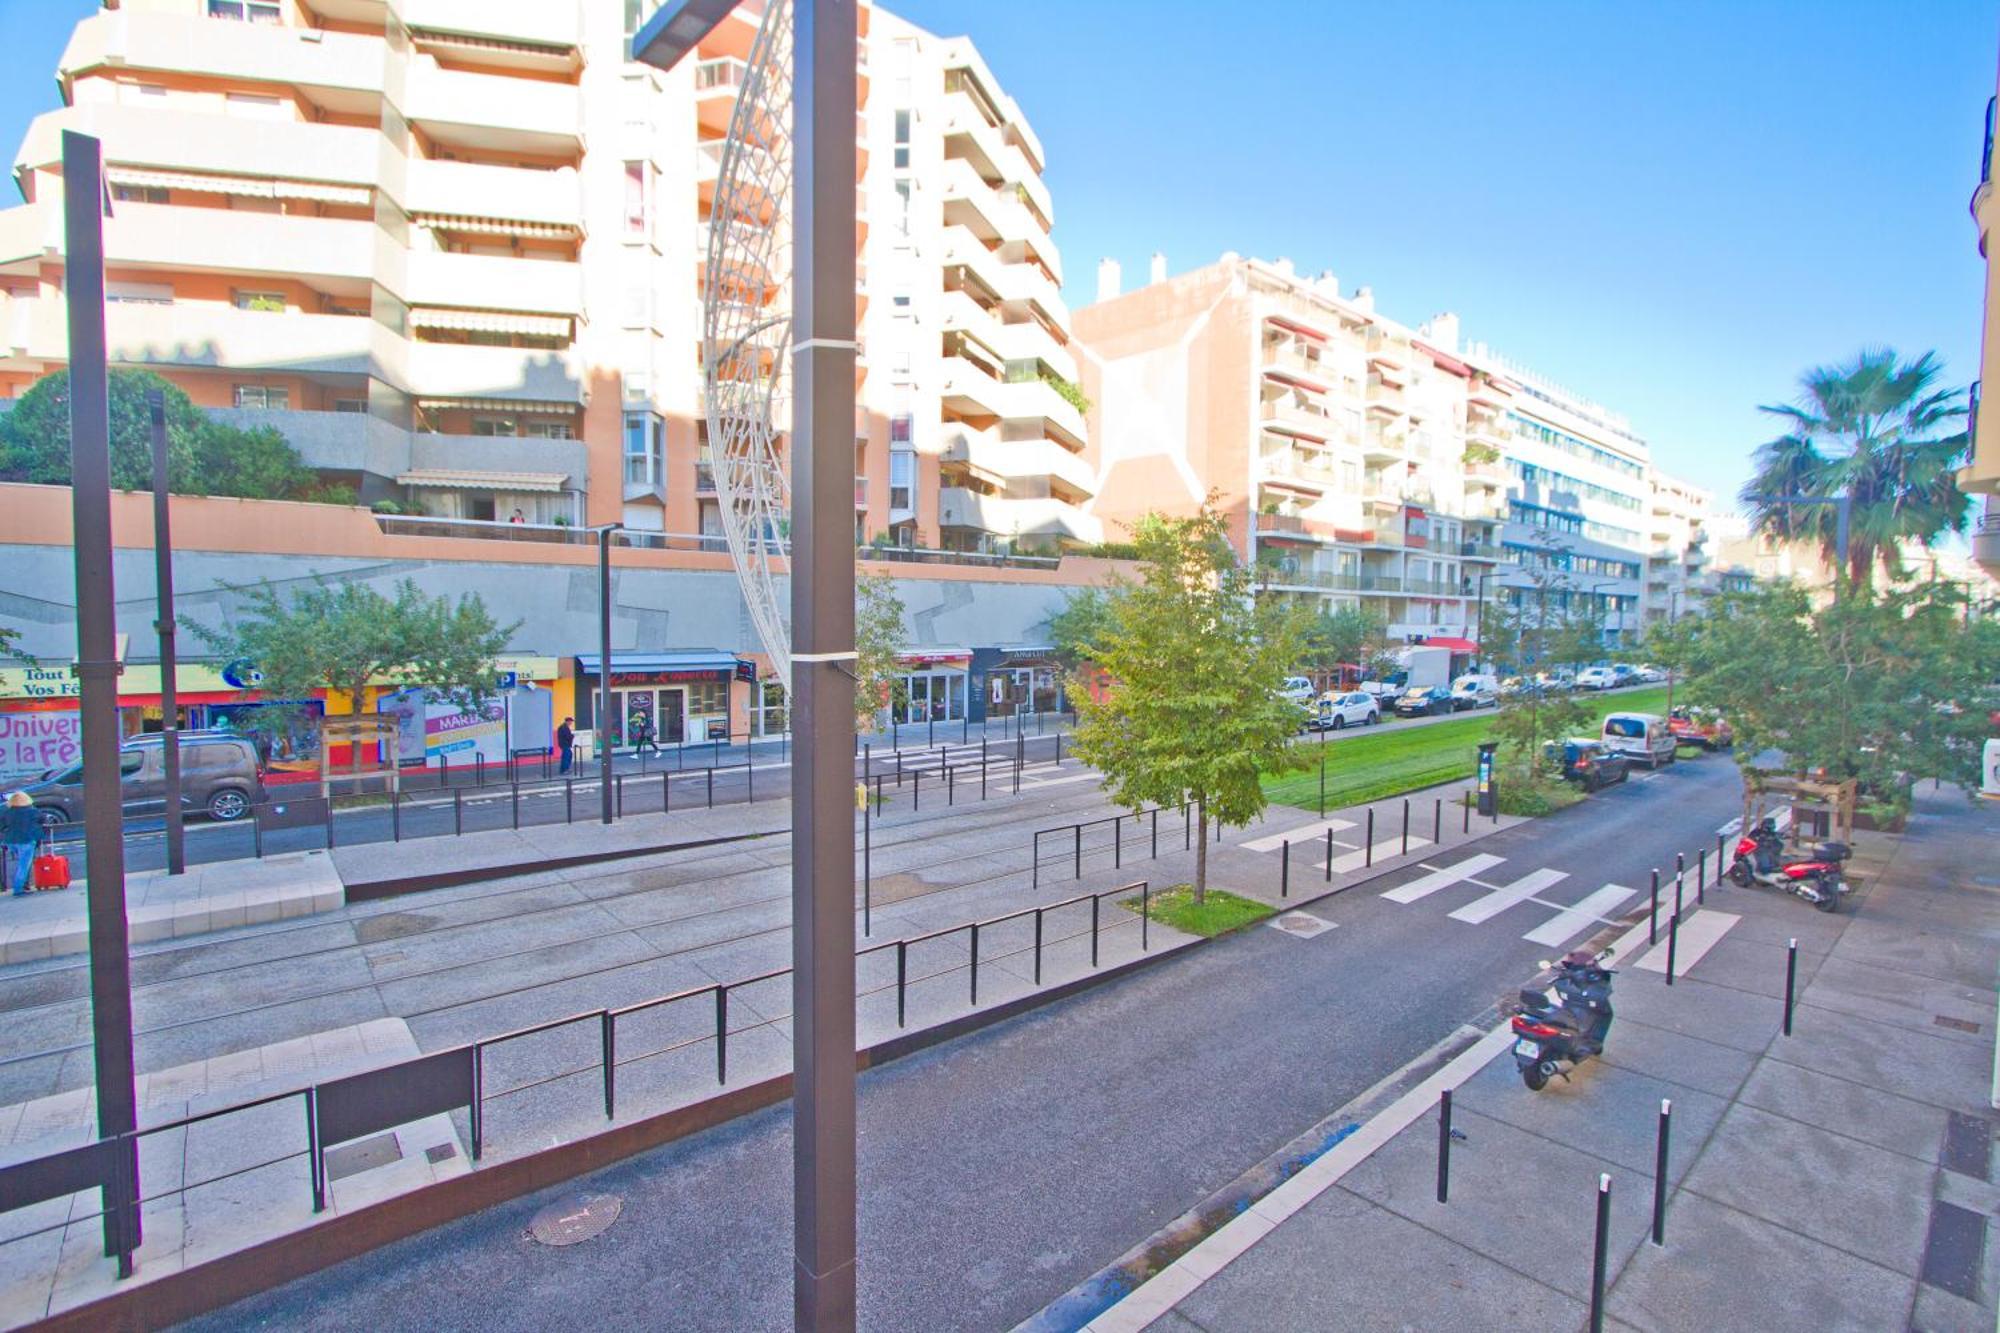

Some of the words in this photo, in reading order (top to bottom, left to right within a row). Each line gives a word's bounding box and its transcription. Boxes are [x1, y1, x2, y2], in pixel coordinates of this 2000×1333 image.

[24, 669, 63, 680] Tout
[23, 684, 55, 695] Vos
[61, 683, 80, 694] Fê
[0, 715, 80, 738] Univer
[16, 742, 36, 763] la
[40, 736, 81, 767] Fê
